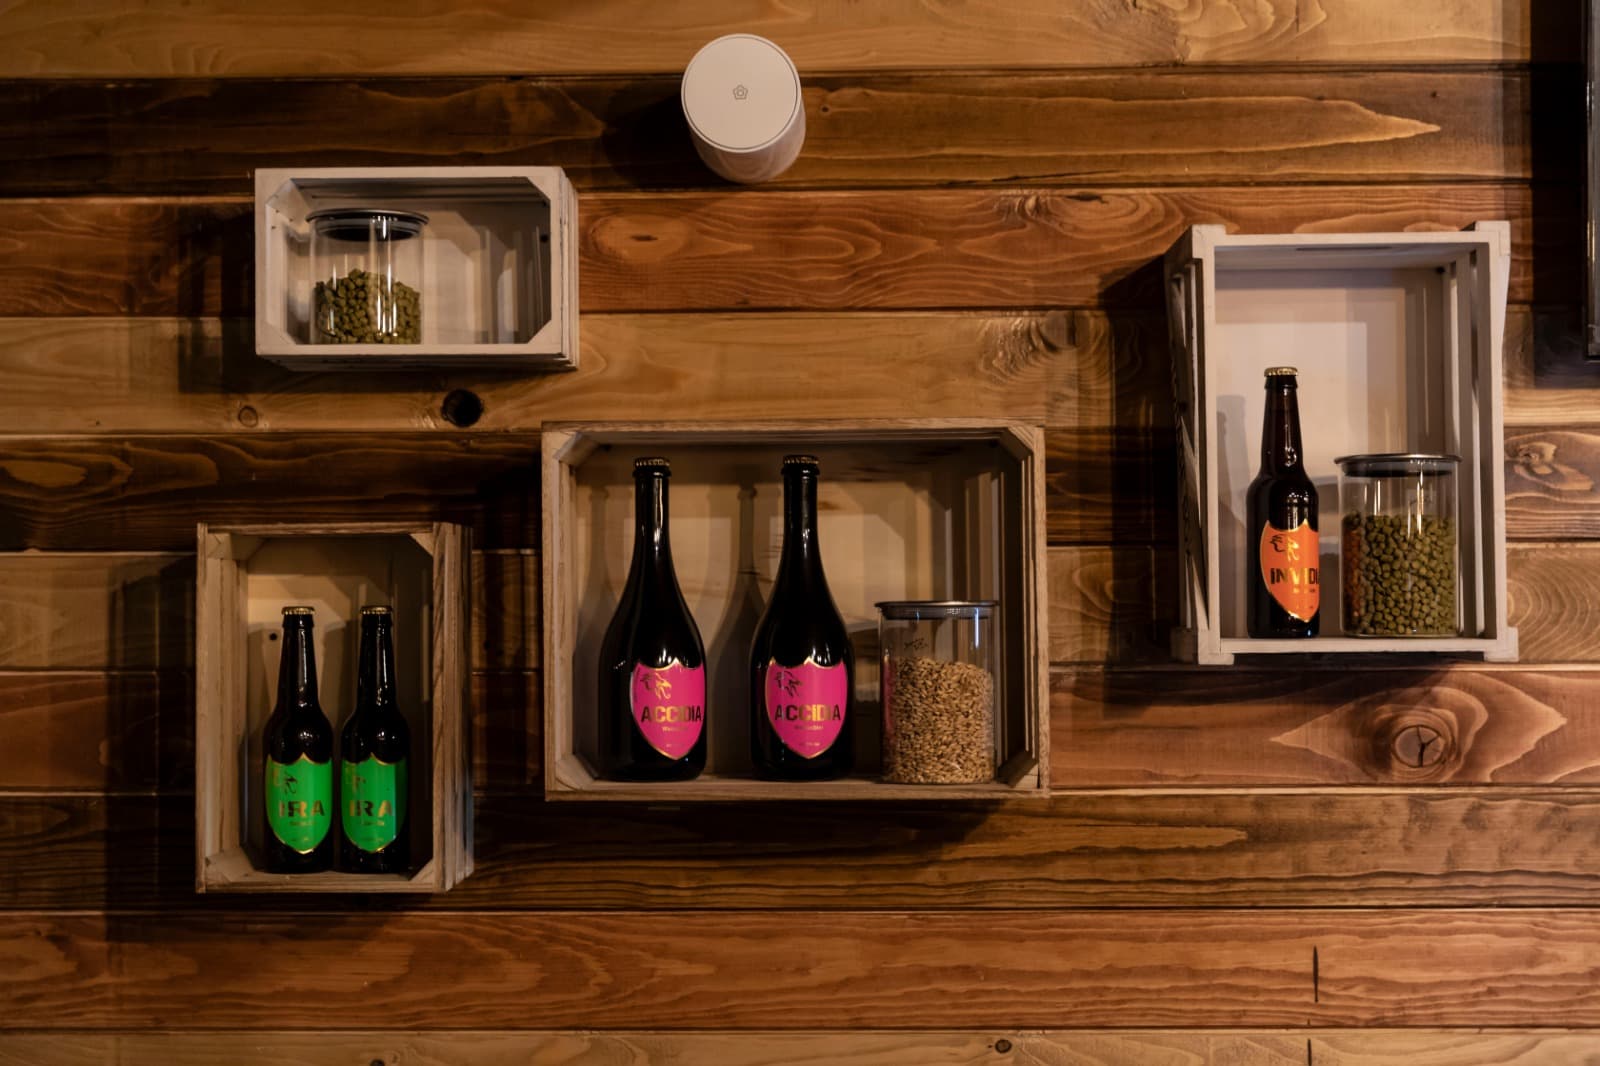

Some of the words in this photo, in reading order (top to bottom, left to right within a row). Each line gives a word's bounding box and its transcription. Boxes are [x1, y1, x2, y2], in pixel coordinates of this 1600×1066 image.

[1270, 567, 1319, 585] INVIDI
[641, 705, 702, 722] ACCIDIA
[774, 704, 841, 721] ACCIDIA
[279, 800, 325, 817] IRA
[349, 800, 393, 817] IRA
